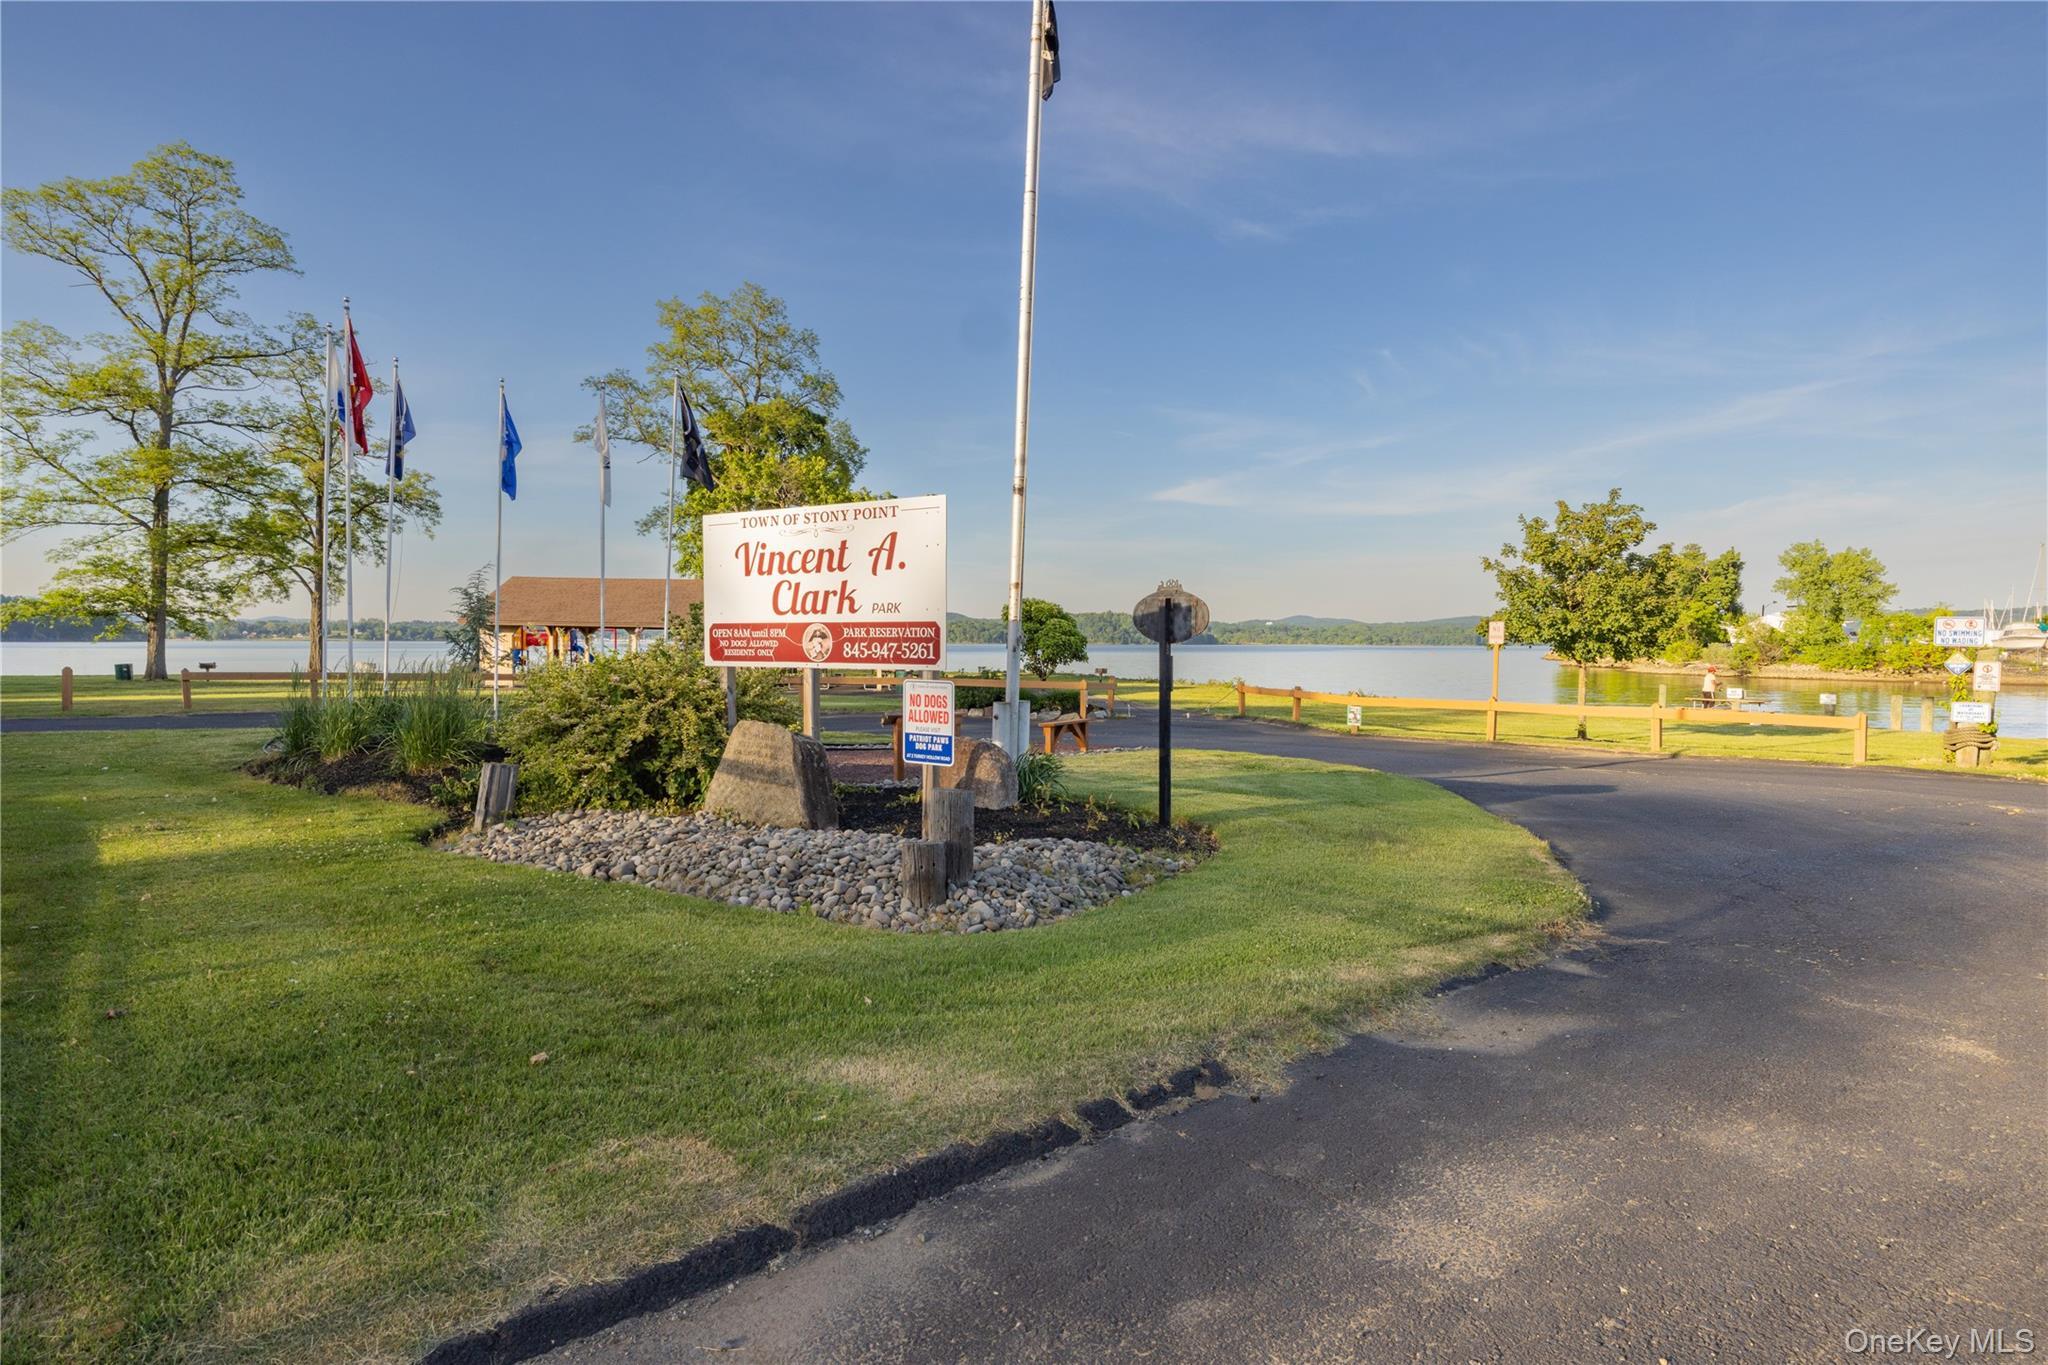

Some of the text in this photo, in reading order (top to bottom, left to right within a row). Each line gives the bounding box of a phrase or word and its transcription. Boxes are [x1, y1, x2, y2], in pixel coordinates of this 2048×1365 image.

[741, 505, 899, 529] TOWN OF STONY POINT
[734, 531, 906, 577] Vincent A.
[772, 579, 902, 616] Clark PARK
[712, 629, 786, 638] OPEN 8AM until 8PM
[843, 626, 935, 638] PARK RESERVATION
[749, 640, 778, 648] ALLOWED
[843, 642, 936, 660] 845-947-5261
[909, 693, 948, 709] NO DOGS
[908, 709, 949, 725] ALLOWED
[909, 734, 949, 744] PATRIOT PAWS
[915, 742, 943, 751] DOG PARK
